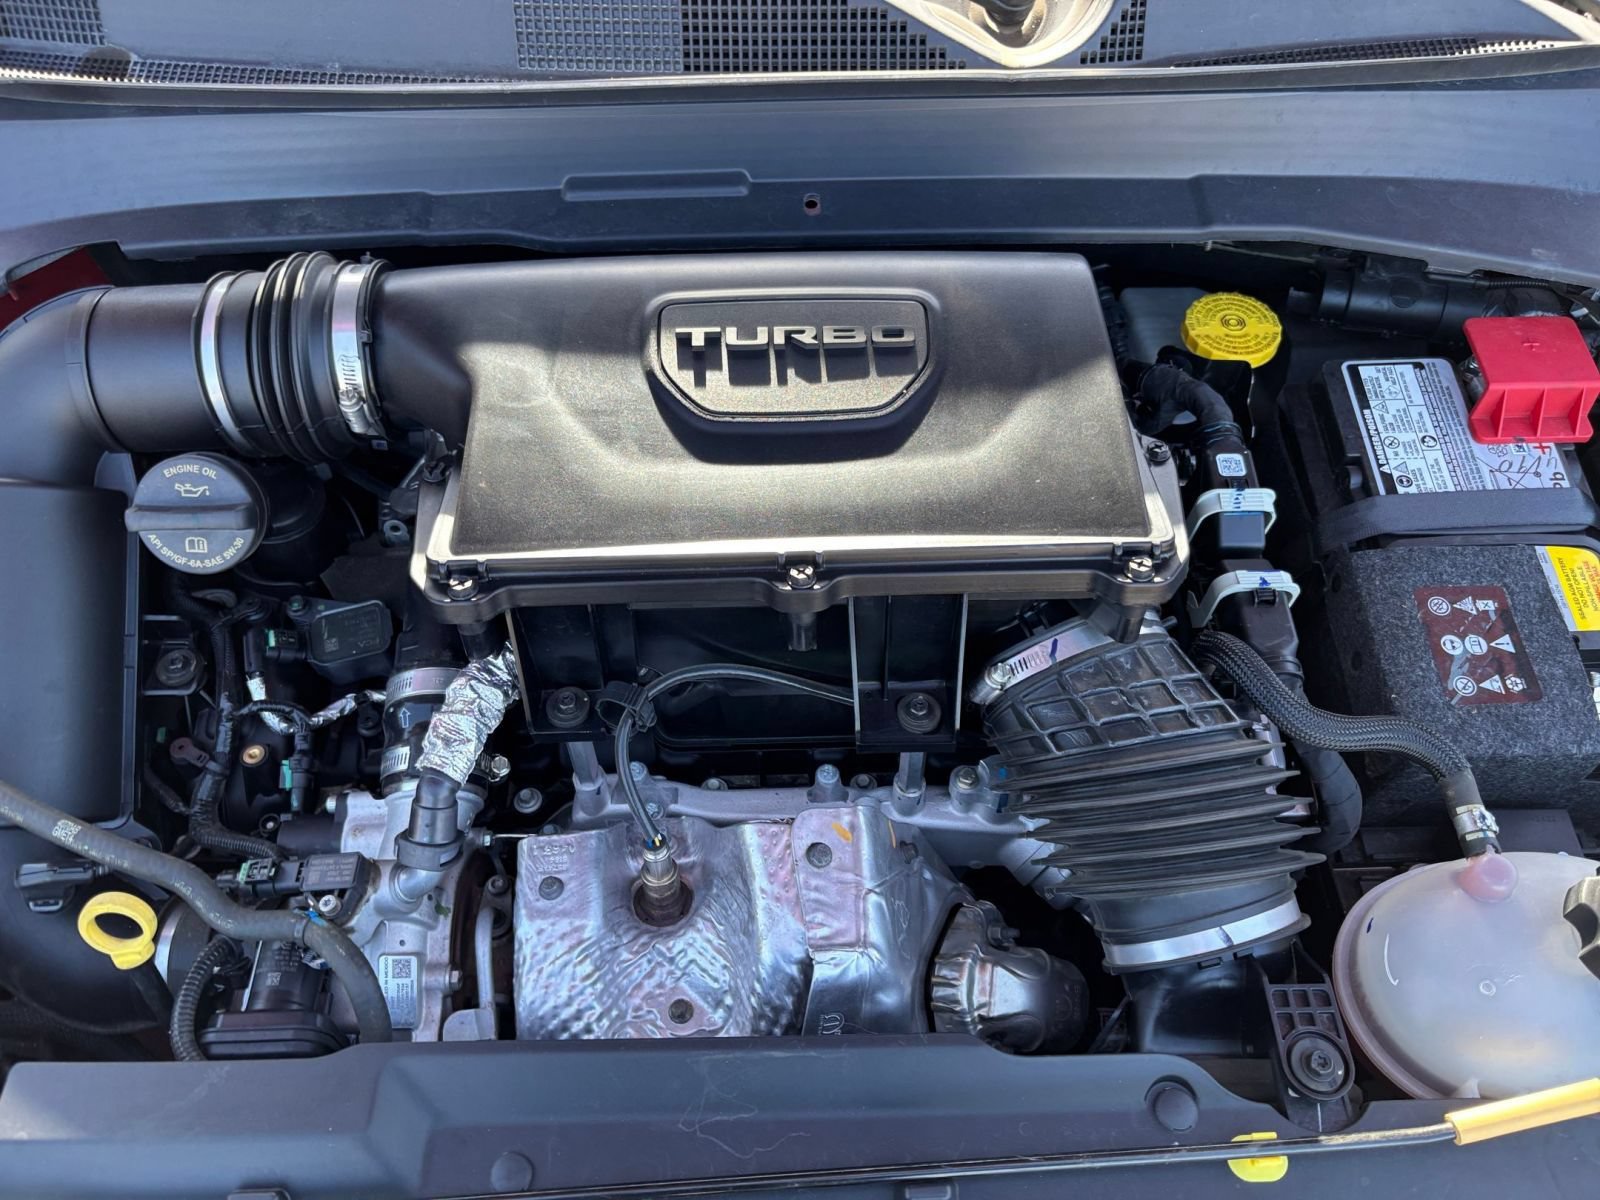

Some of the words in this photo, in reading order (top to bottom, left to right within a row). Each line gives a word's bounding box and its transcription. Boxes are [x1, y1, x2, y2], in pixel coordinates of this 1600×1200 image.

[675, 325, 916, 349] TURBO
[1362, 409, 1388, 465] DANGER/POISON
[163, 464, 200, 478] ENGINE
[202, 466, 217, 479] OIL
[147, 534, 162, 550] API
[223, 537, 245, 560] 5W-30
[1555, 557, 1573, 582] BATTERY
